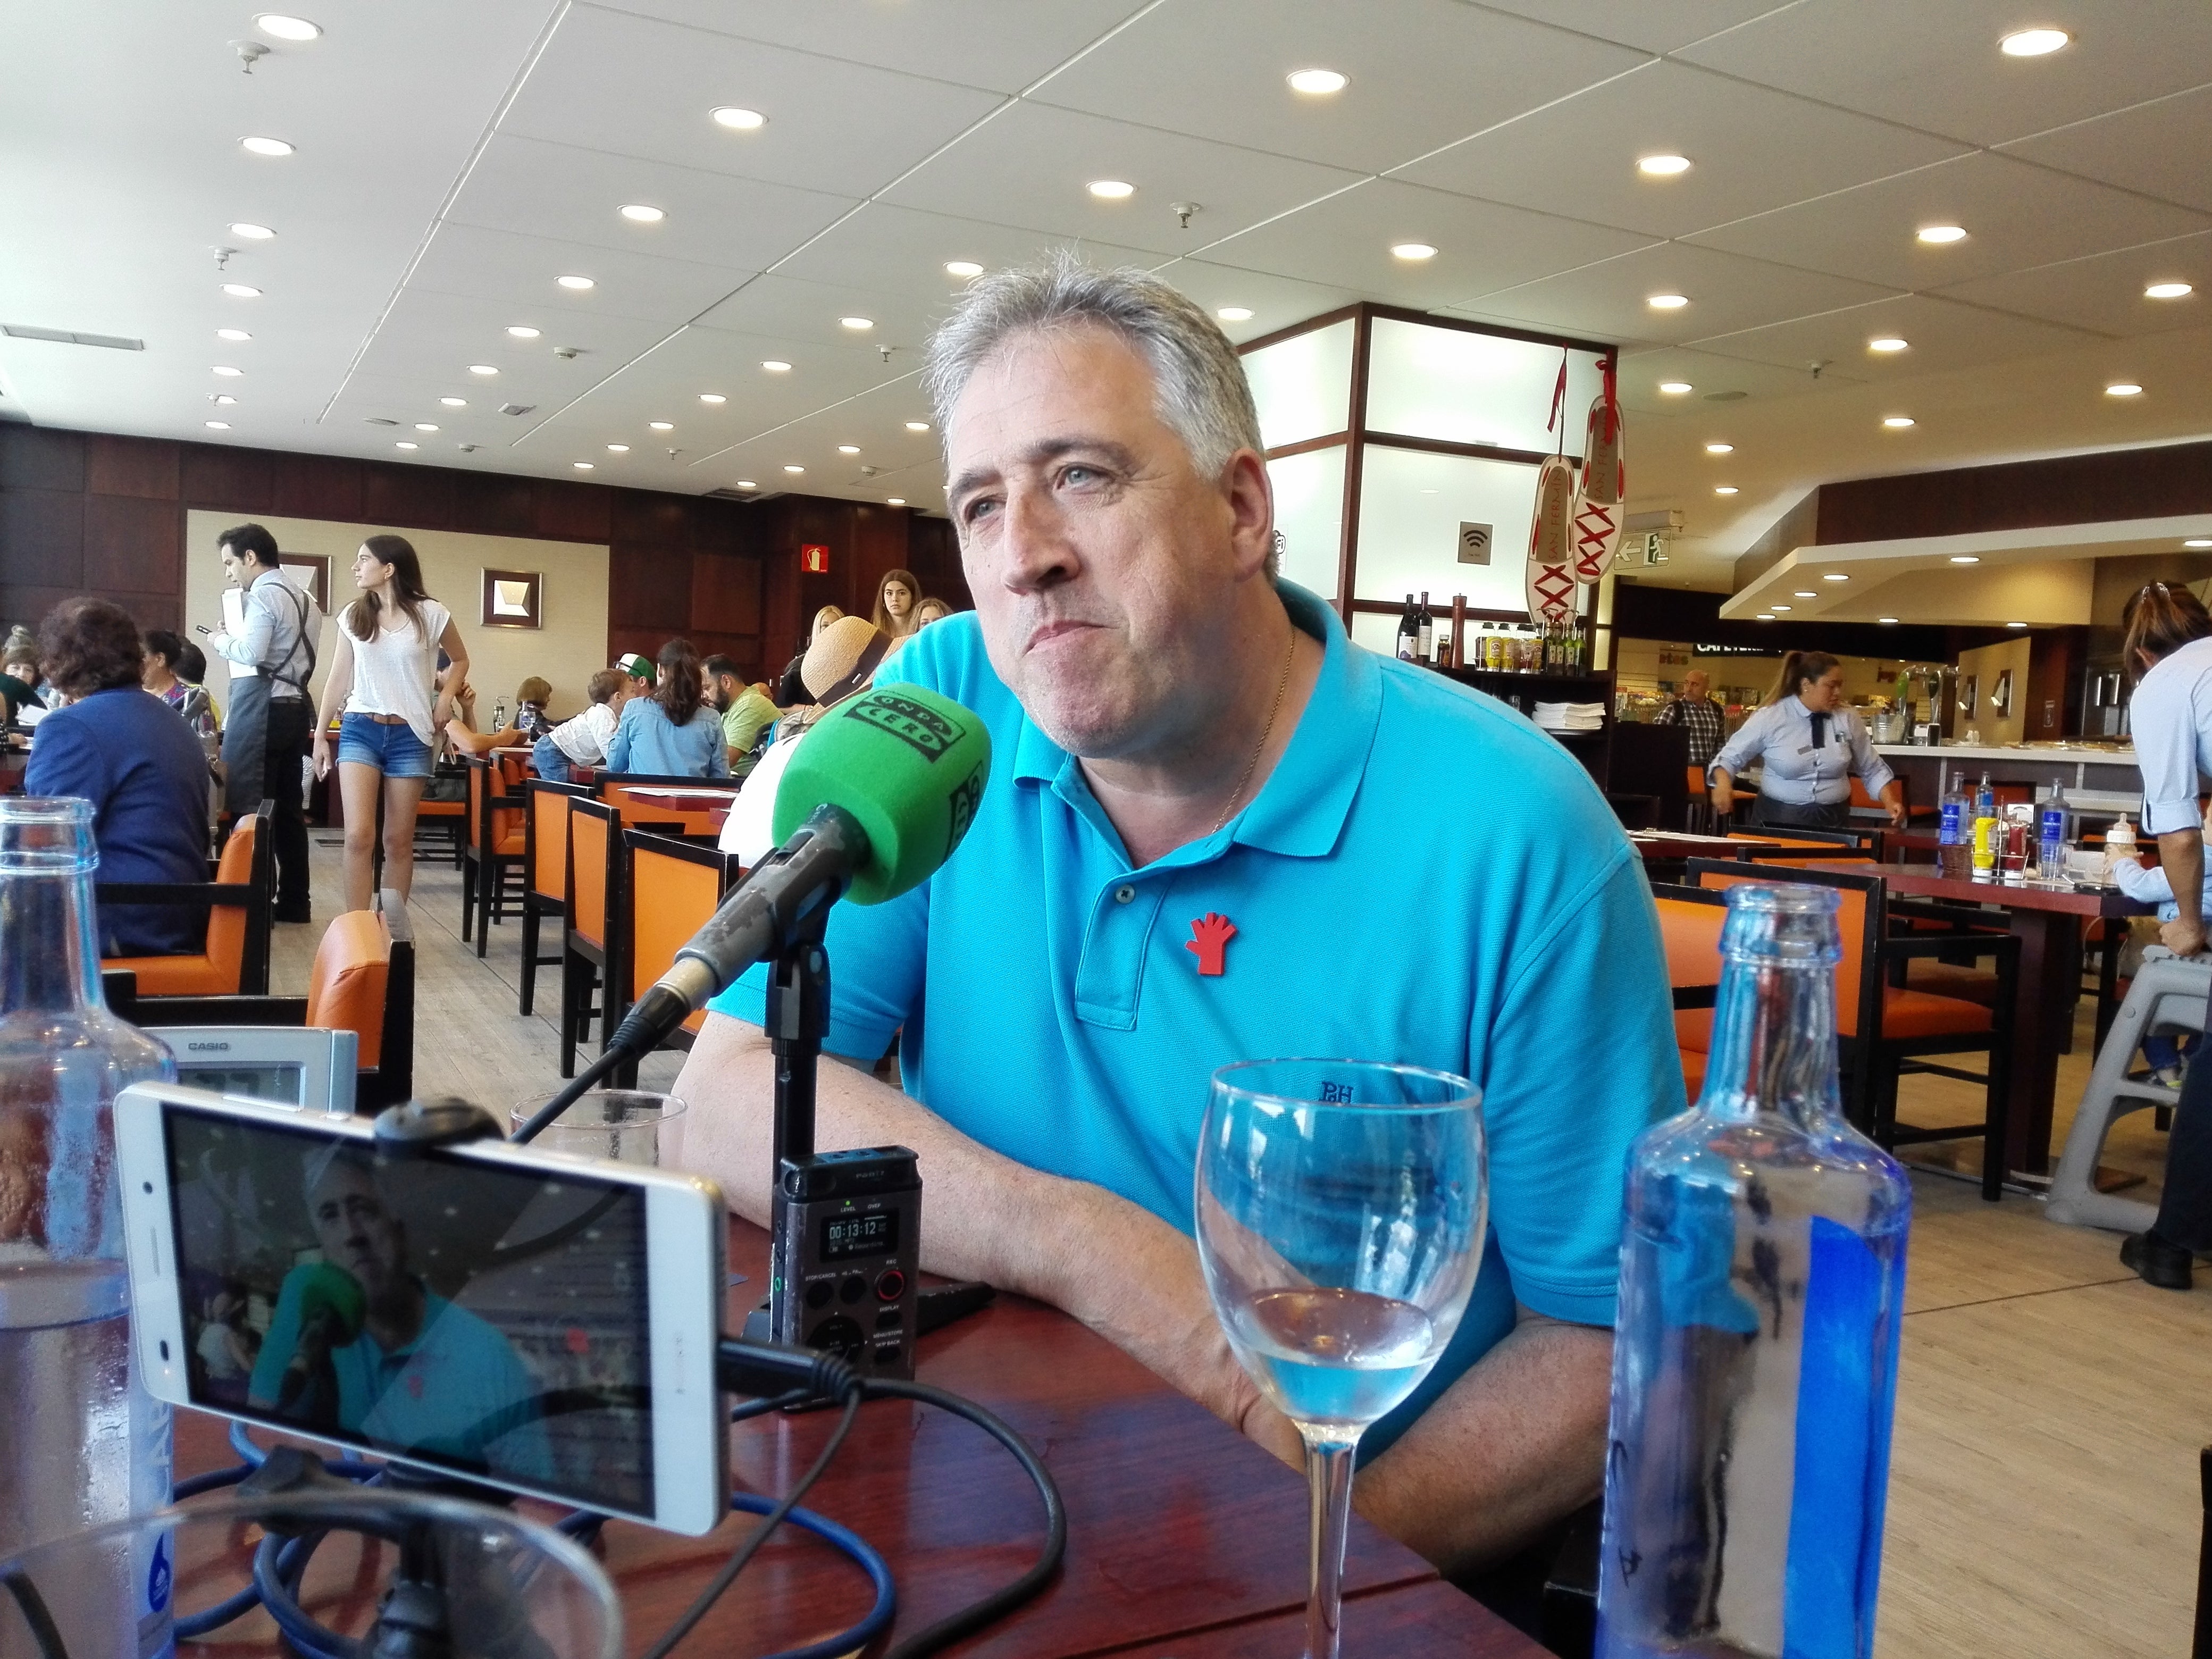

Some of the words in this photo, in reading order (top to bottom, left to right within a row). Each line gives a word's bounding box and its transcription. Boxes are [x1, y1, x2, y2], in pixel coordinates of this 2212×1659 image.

[1548, 532, 1559, 559] SAN
[868, 707, 934, 744] CERO
[881, 697, 944, 730] ONDA
[188, 1042, 229, 1051] CASIO
[829, 1221, 876, 1239] 00:13:12
